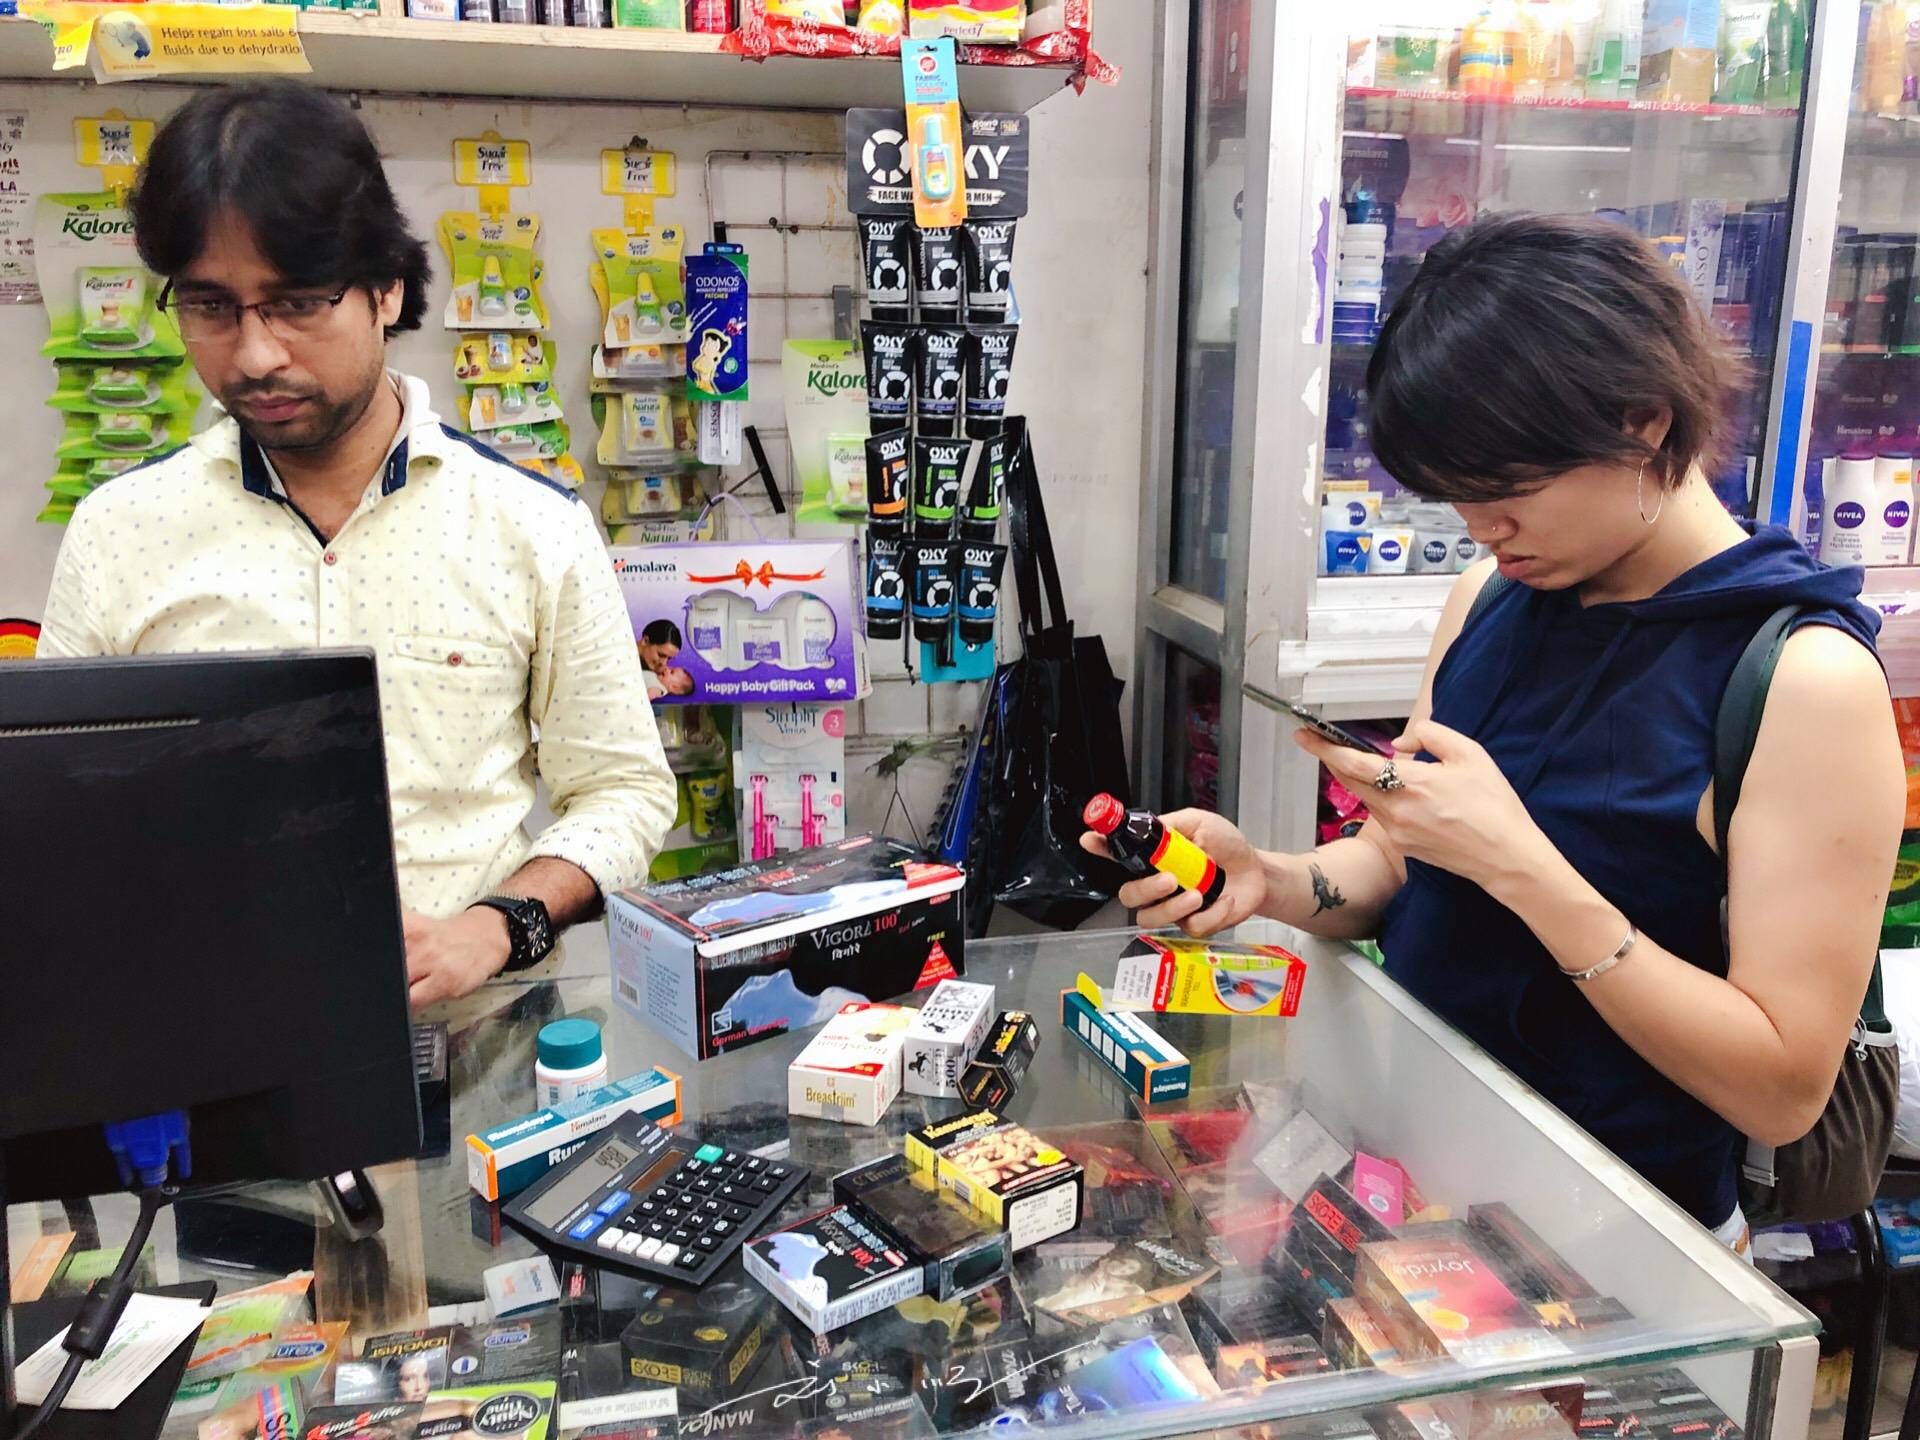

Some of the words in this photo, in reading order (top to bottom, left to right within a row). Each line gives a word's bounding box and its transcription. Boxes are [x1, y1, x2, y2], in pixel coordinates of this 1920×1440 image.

[161, 26, 194, 39] Helps
[198, 27, 233, 39] regain
[237, 26, 257, 37] lost
[163, 43, 194, 55] fluids
[198, 44, 219, 55] due
[222, 45, 235, 55] to
[878, 190, 900, 201] FACE
[973, 191, 993, 202] MEN
[868, 221, 897, 236] OXY
[977, 225, 1008, 240] OXY
[695, 276, 740, 288] ODOMOS
[873, 334, 906, 349] OXY
[927, 334, 960, 349] OXY
[981, 334, 1010, 349] OXY
[880, 437, 905, 455] OXY
[929, 446, 960, 461] OXY
[1886, 510, 1908, 518] NIVEA
[640, 532, 680, 544] Natura
[917, 548, 948, 561] OXY
[964, 548, 994, 562] OXY
[1380, 547, 1400, 555] NIVEA
[613, 557, 677, 574] Himalaya
[705, 682, 740, 696] Happy
[741, 681, 769, 695] Baby
[769, 681, 789, 692] Gift
[789, 680, 815, 692] Pack
[829, 714, 840, 728] 3
[874, 910, 899, 933] 100
[926, 931, 946, 943] FREE
[712, 1029, 748, 1047] German
[1391, 1257, 1476, 1279] Joyride
[633, 1362, 680, 1384] SKORE
